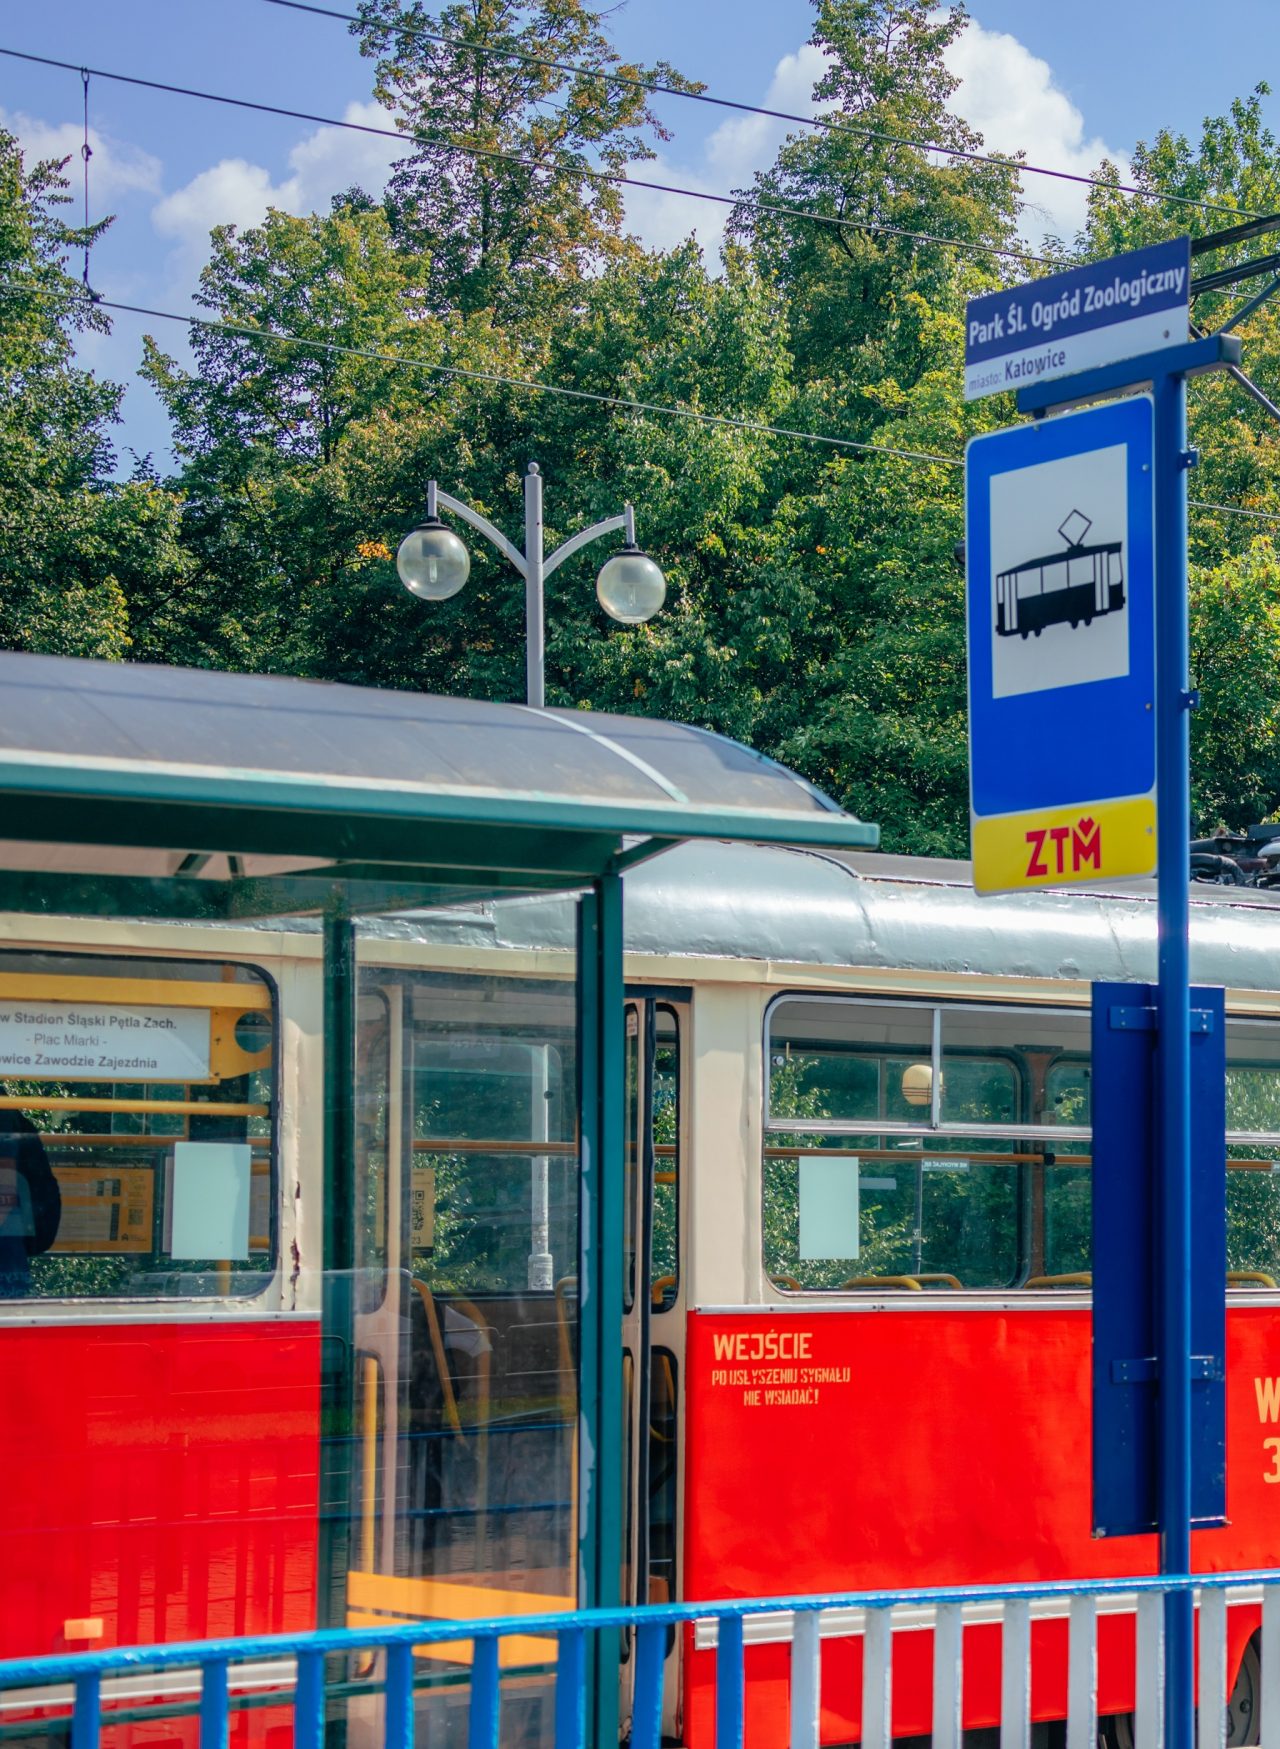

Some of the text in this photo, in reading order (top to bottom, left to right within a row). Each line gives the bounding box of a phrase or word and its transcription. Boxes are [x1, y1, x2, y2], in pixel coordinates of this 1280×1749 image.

[969, 266, 1186, 347] Park Śl. Ogród Zoologiczny
[1004, 348, 1066, 382] Katowice
[1025, 817, 1101, 877] ZTM
[14, 1012, 64, 1026] Stadion
[67, 1011, 106, 1029] Śląski
[109, 1015, 141, 1031] Pętla
[144, 1017, 177, 1030] Zach.
[34, 1033, 61, 1047] Plac
[64, 1034, 99, 1047] Miarki
[0, 1053, 158, 1071] wice Zawodzie Zajezdnia
[713, 1329, 813, 1361] WEJŚCIE
[712, 1367, 851, 1386] PO USŁYSZENIU SYGNAŁU
[743, 1386, 819, 1406] NIE WSIADAĆ!
